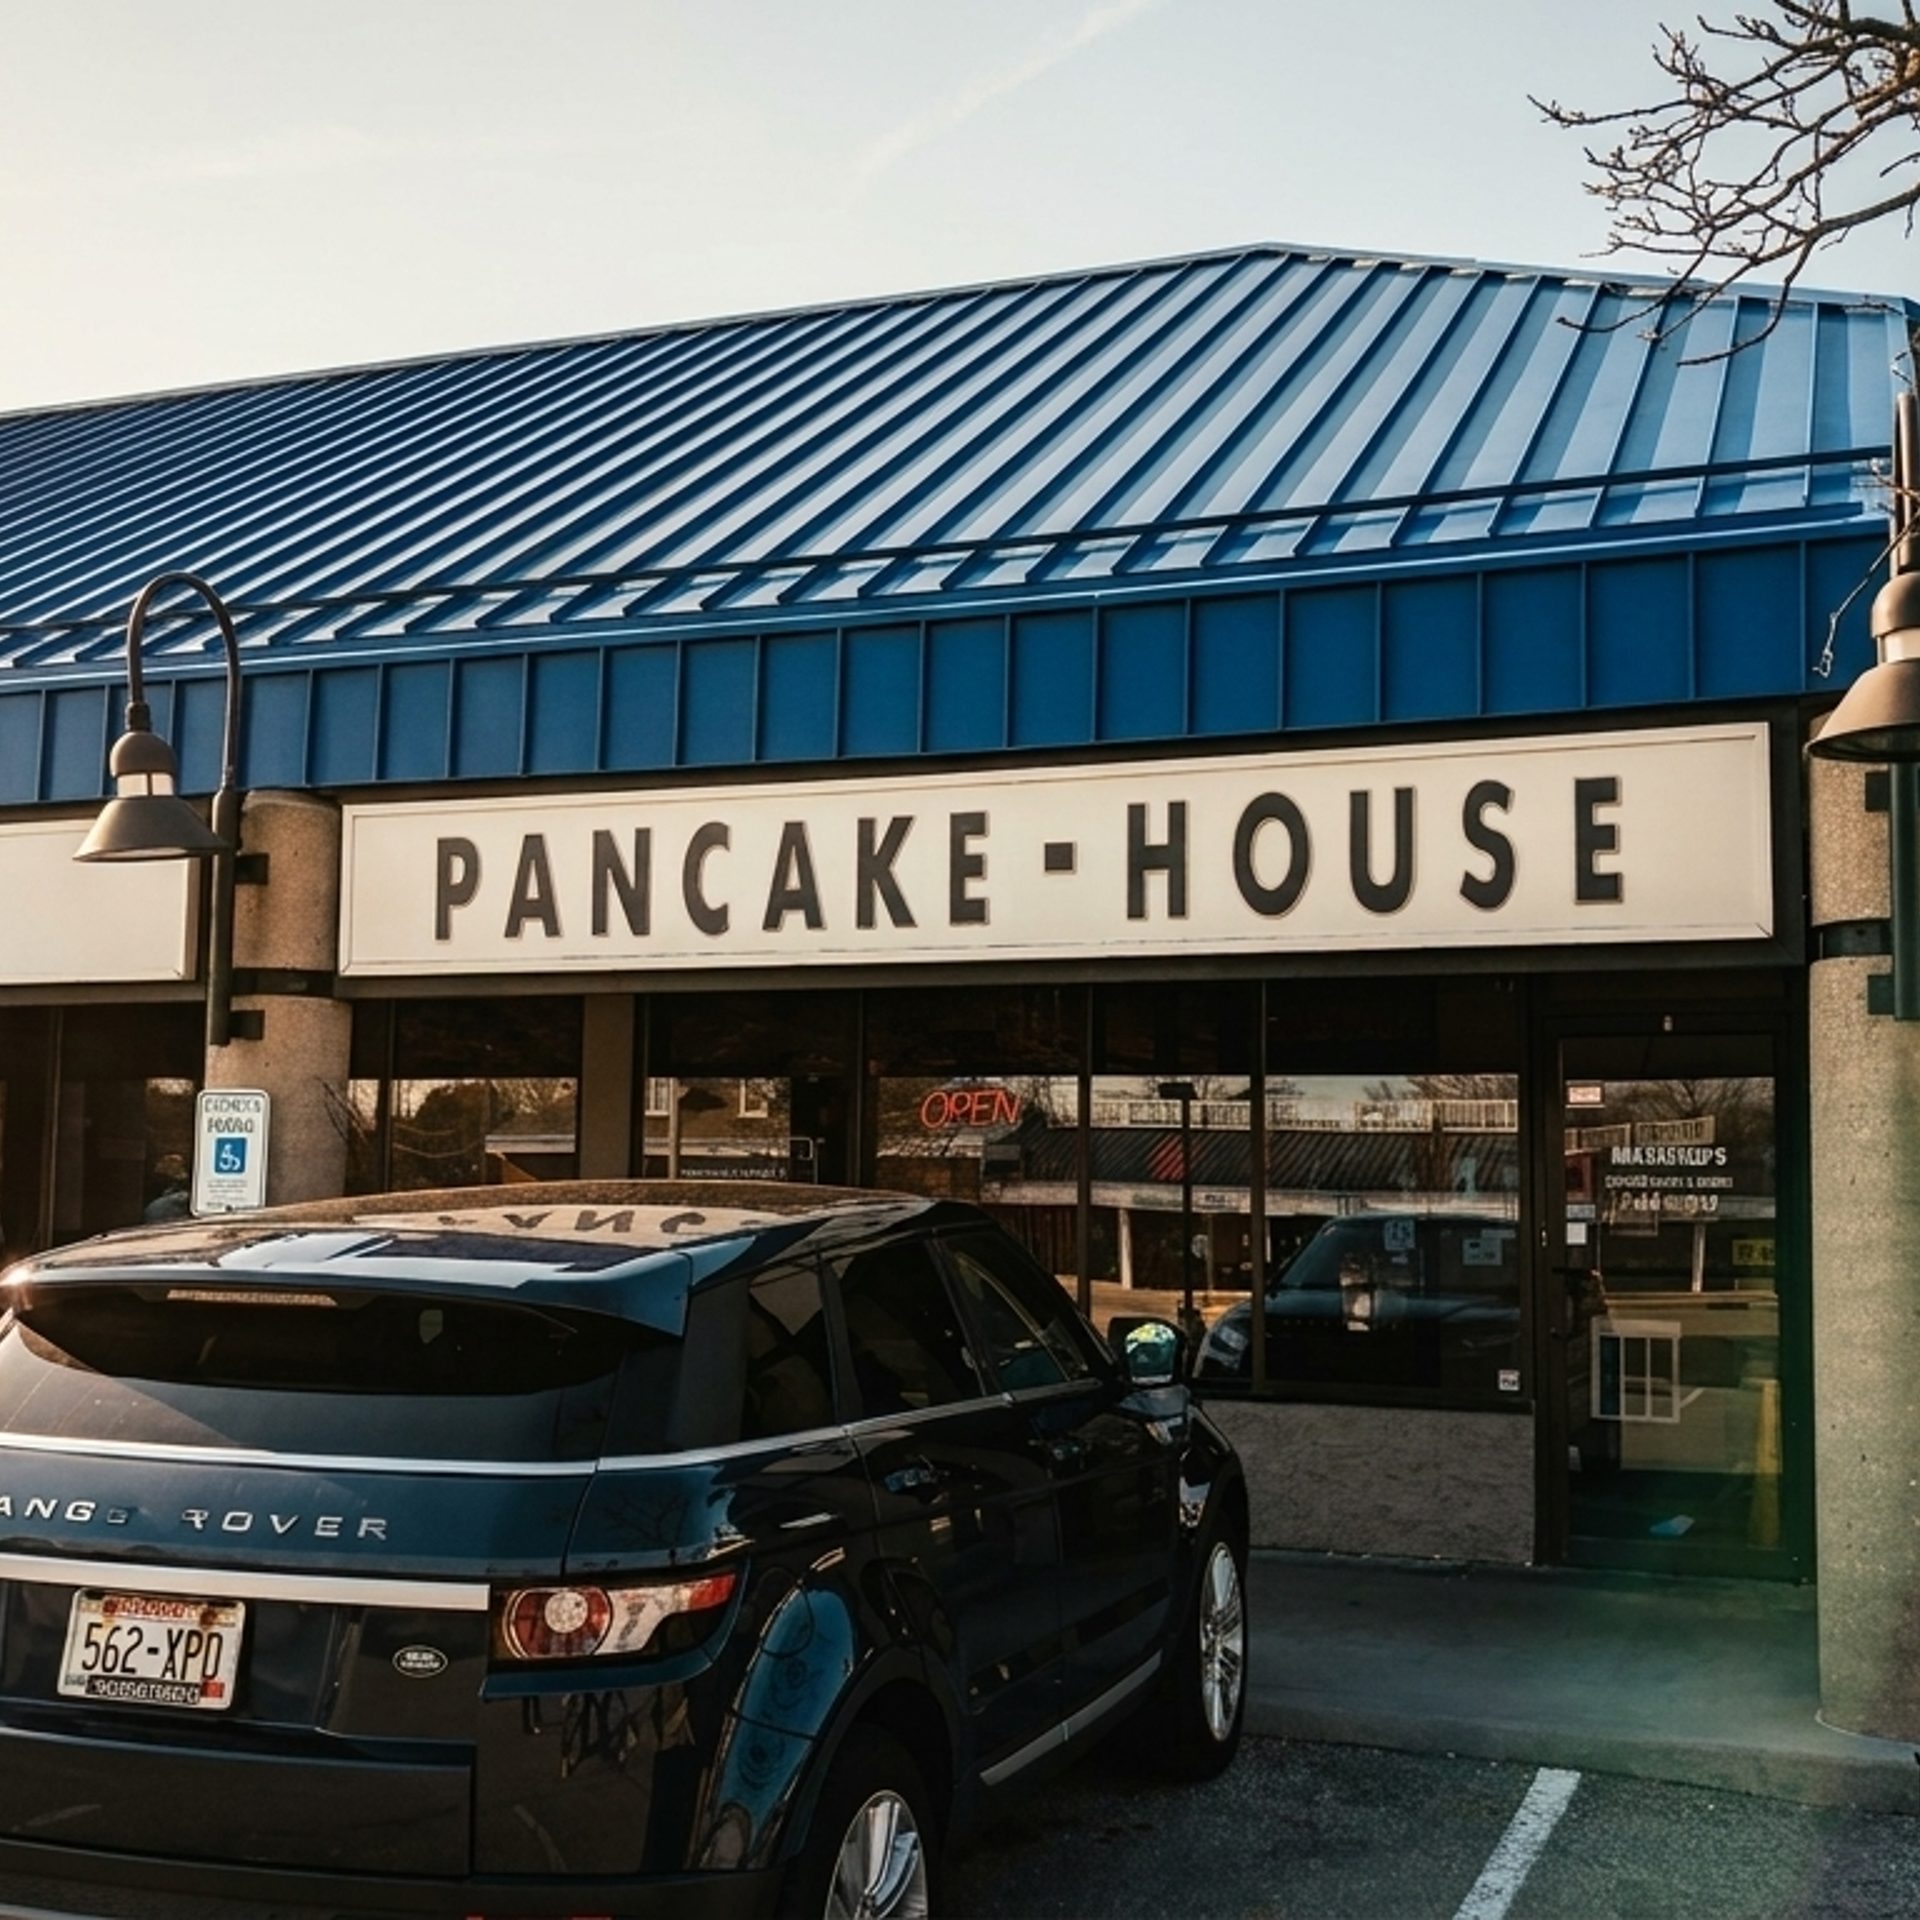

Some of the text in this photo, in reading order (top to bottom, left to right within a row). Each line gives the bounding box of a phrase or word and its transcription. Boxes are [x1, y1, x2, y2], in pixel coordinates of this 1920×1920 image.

[435, 775, 1625, 942] PANCAKE HOUSE
[920, 1088, 1022, 1129] OPEN
[181, 1508, 388, 1541] ROVER
